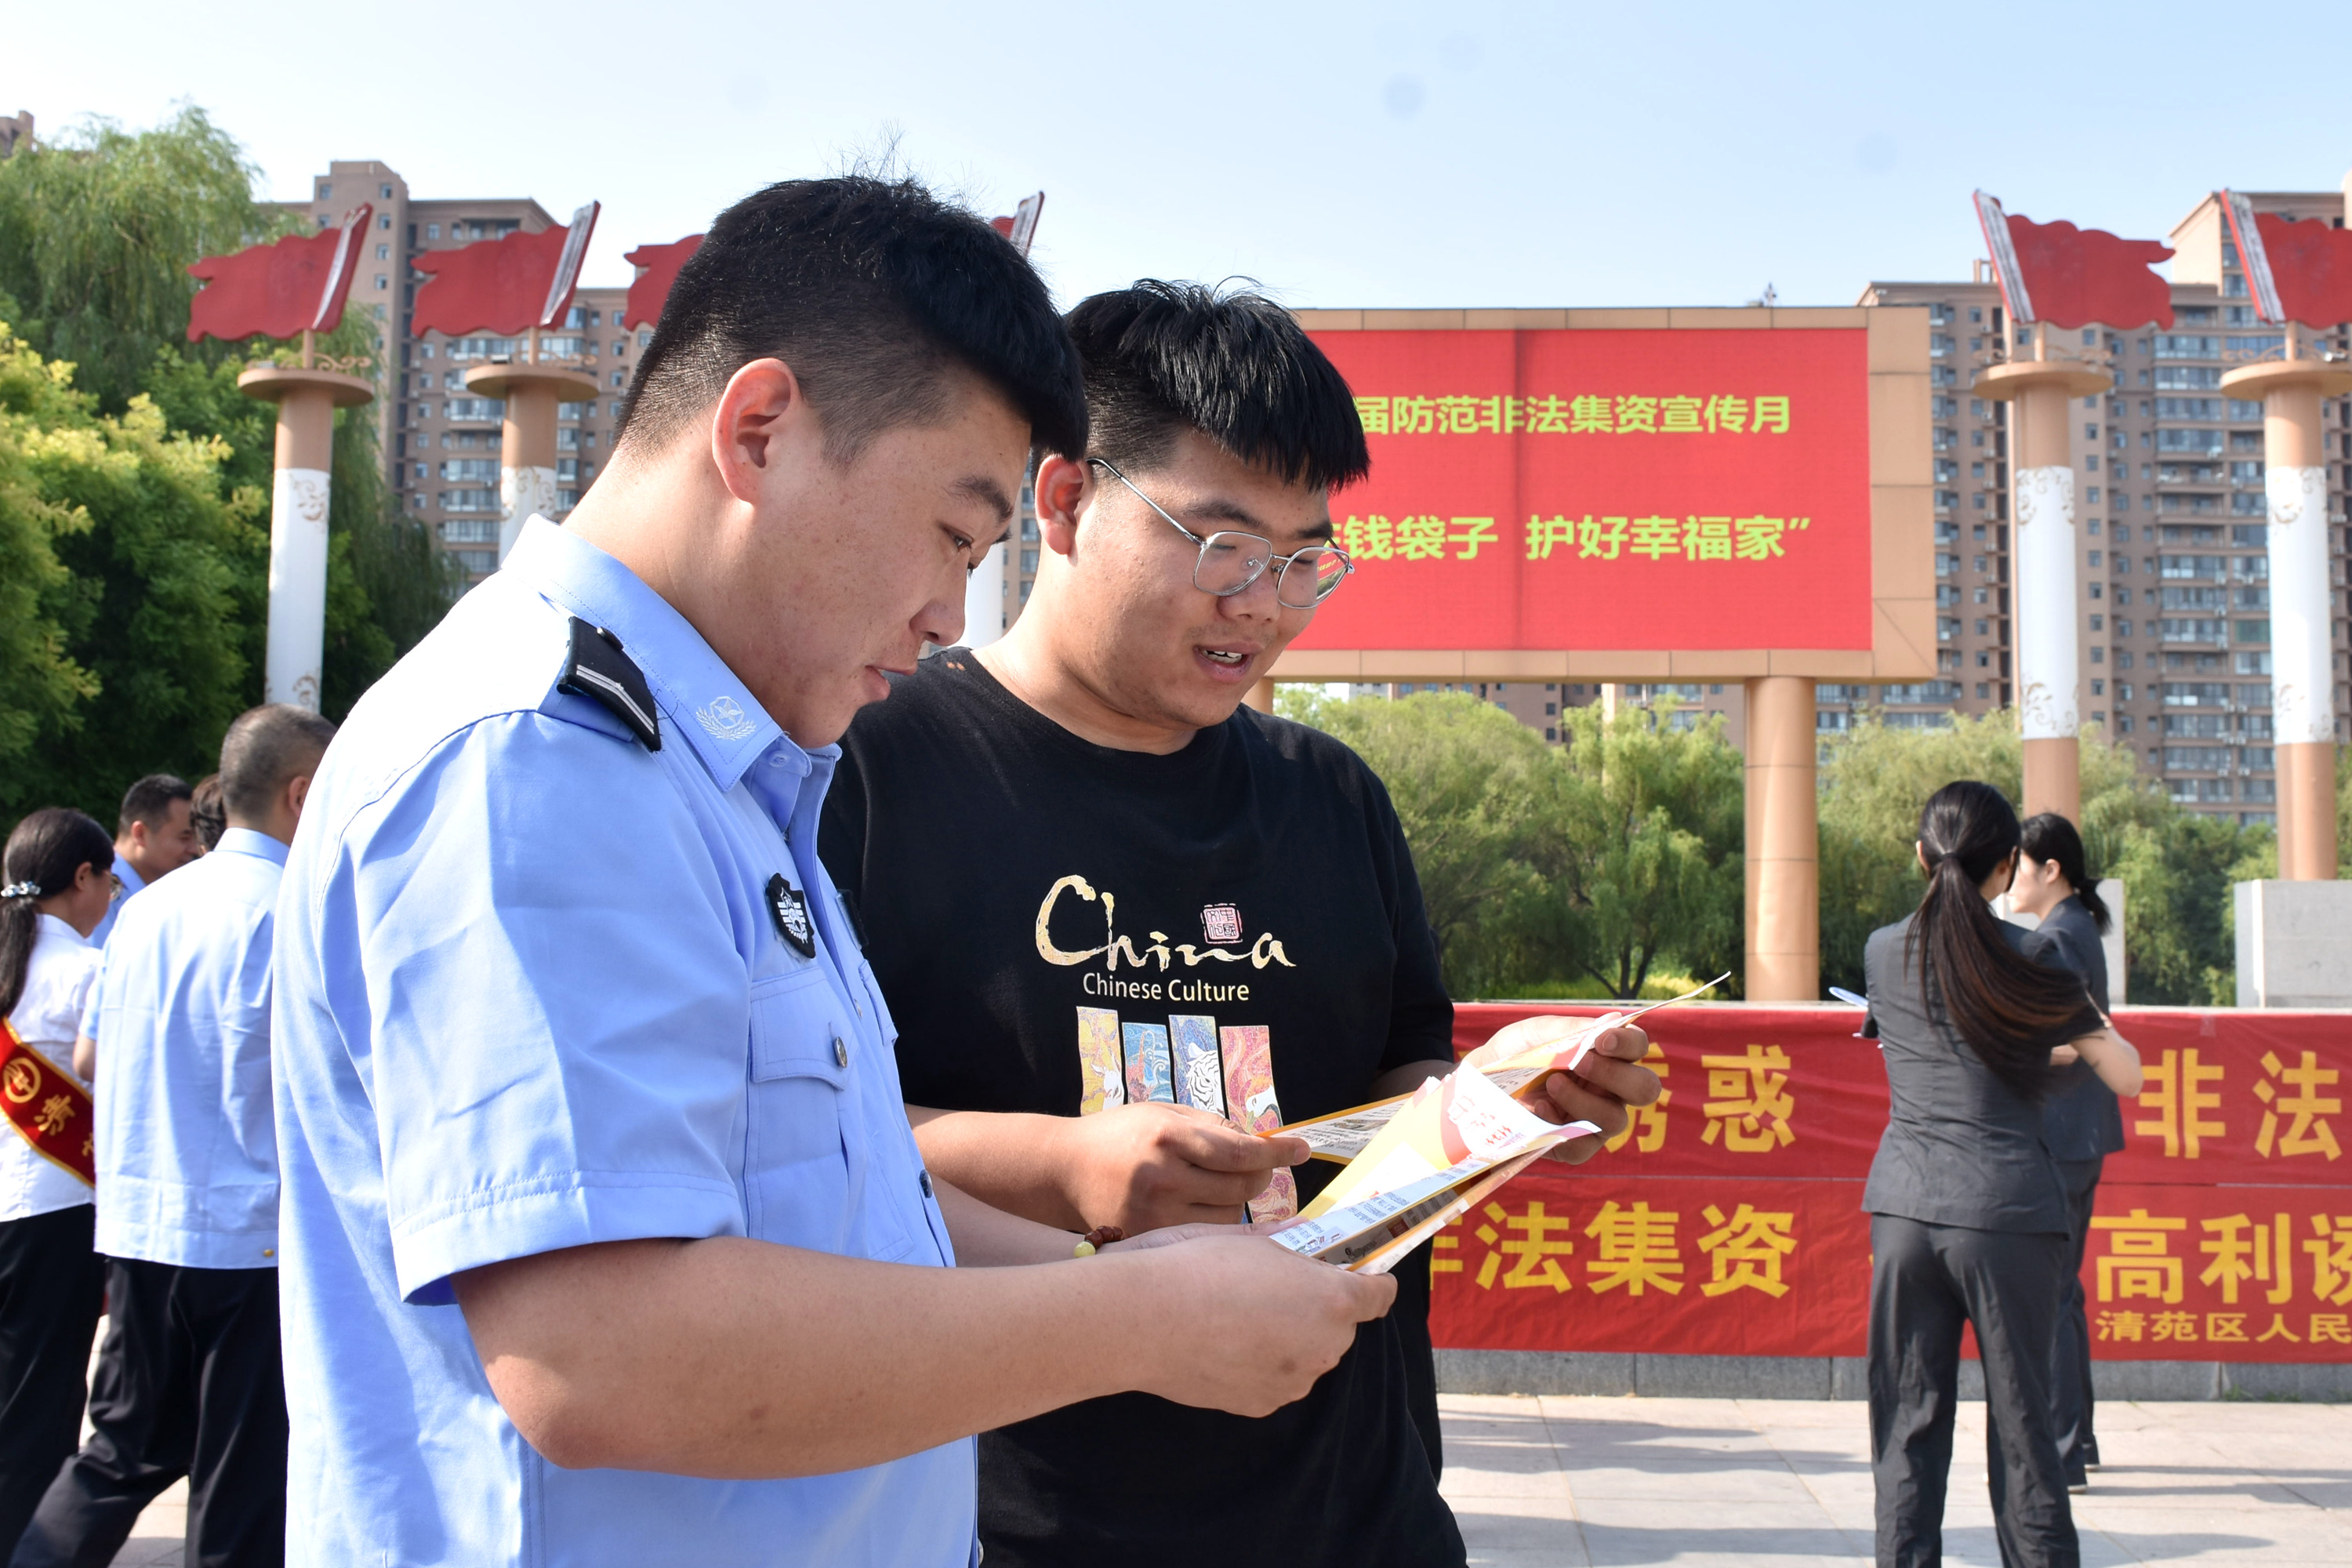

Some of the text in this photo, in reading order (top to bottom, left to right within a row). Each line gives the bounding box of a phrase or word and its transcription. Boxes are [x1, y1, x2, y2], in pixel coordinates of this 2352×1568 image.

[1352, 394, 1790, 435] 届防范非法集资宣传月
[1036, 874, 1297, 972] China
[1083, 972, 1250, 1002] Chinese Culture
[2135, 1048, 2342, 1161] 非法
[2095, 1310, 2352, 1344] 清苑区人民
